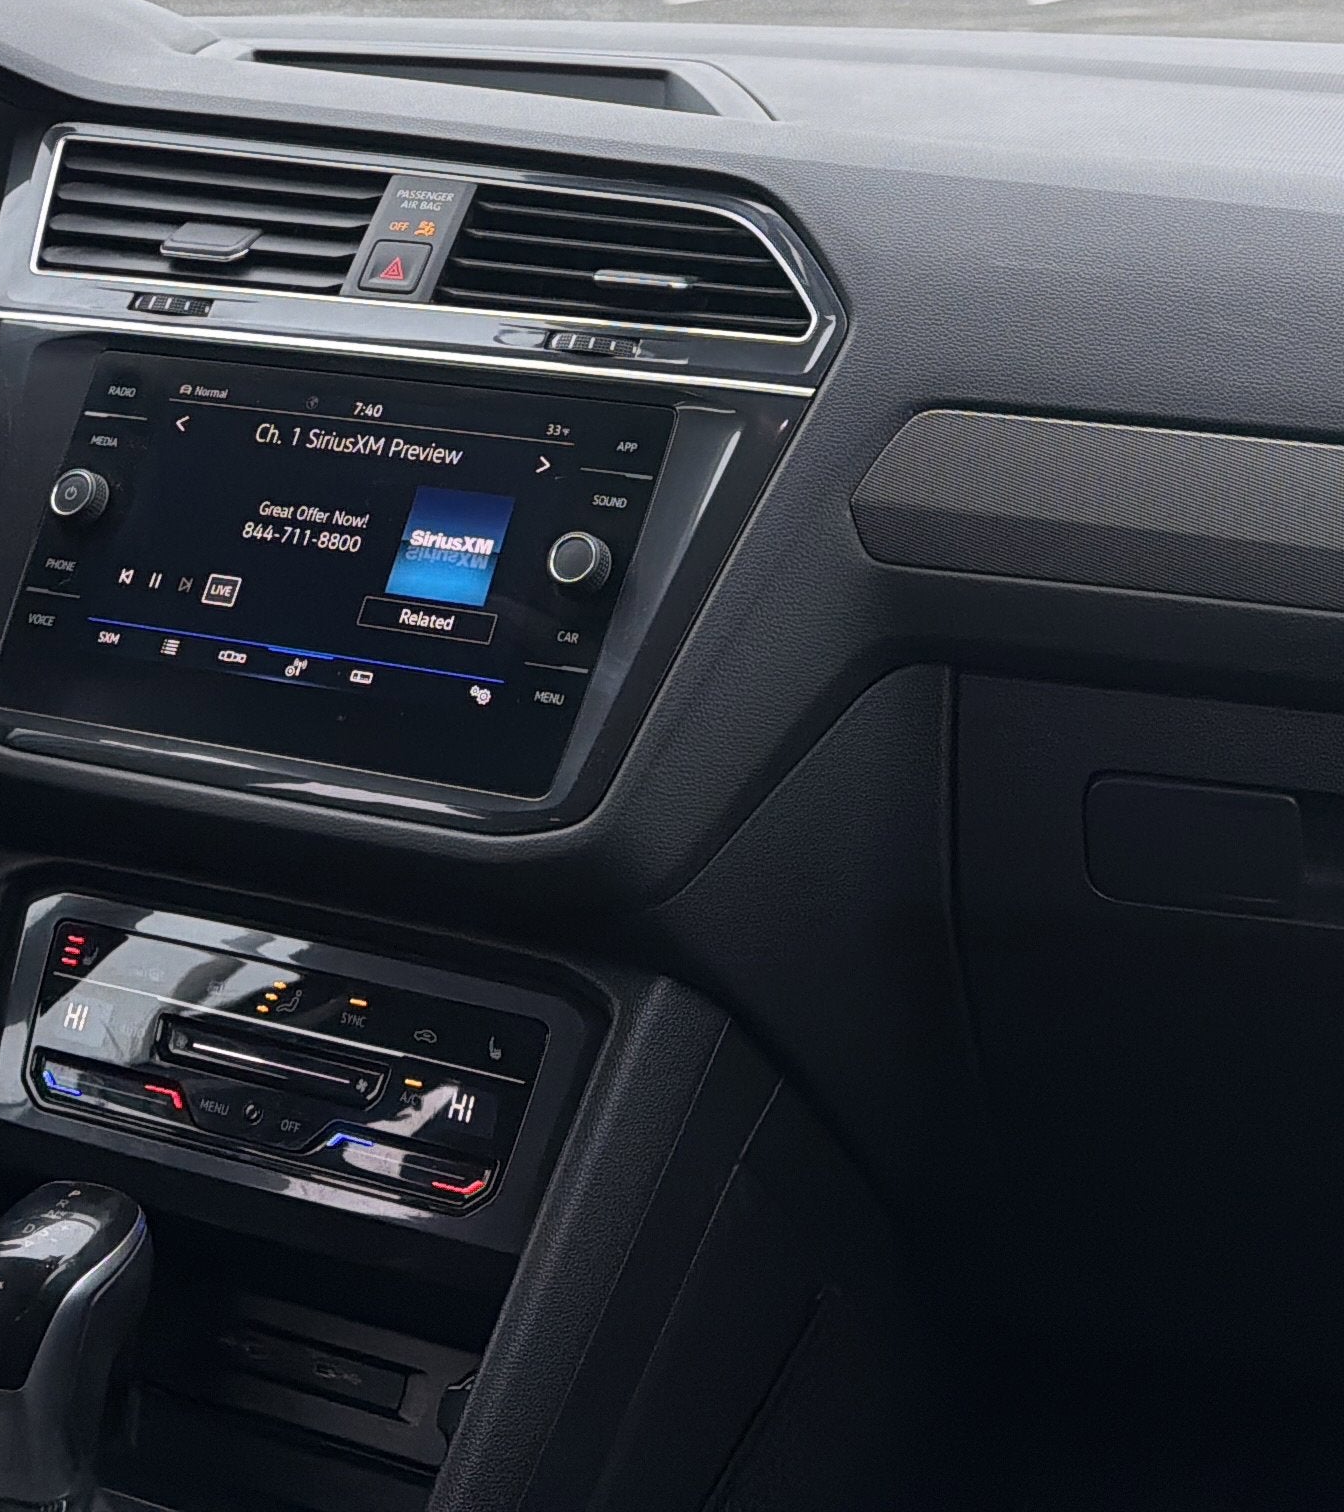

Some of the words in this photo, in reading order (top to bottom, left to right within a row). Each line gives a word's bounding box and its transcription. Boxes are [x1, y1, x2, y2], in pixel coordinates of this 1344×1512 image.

[396, 189, 455, 202] PASSENGER
[400, 200, 419, 210] AIR
[419, 201, 442, 212] BAG
[388, 221, 410, 232] OFF
[108, 385, 137, 398] RADIO
[194, 386, 229, 399] Normal
[353, 402, 384, 418] 7:40
[89, 435, 119, 448] MEDIA
[256, 423, 282, 445] Ch.
[292, 428, 302, 446] 1
[306, 428, 386, 457] SiriusXM
[388, 439, 464, 466] Preview
[616, 440, 639, 454] APP
[592, 494, 628, 509] SOUND
[258, 501, 294, 519] Great
[296, 506, 331, 524] Offer
[334, 510, 370, 529] Now!
[242, 521, 362, 554] 844-711-8800
[410, 529, 495, 556] SiriusXM
[45, 557, 77, 572] PHONE
[210, 583, 233, 597] LIVE
[28, 612, 56, 627] VOICE
[398, 608, 455, 631] Related
[97, 631, 121, 645] SXM
[557, 630, 579, 645] CAR
[534, 690, 565, 706] MENU
[63, 1002, 89, 1032] HI
[340, 1011, 368, 1029] SYNC
[399, 1091, 419, 1106] A/C
[199, 1098, 231, 1116] MENU
[448, 1092, 476, 1124] HI
[280, 1118, 302, 1135] OFF
